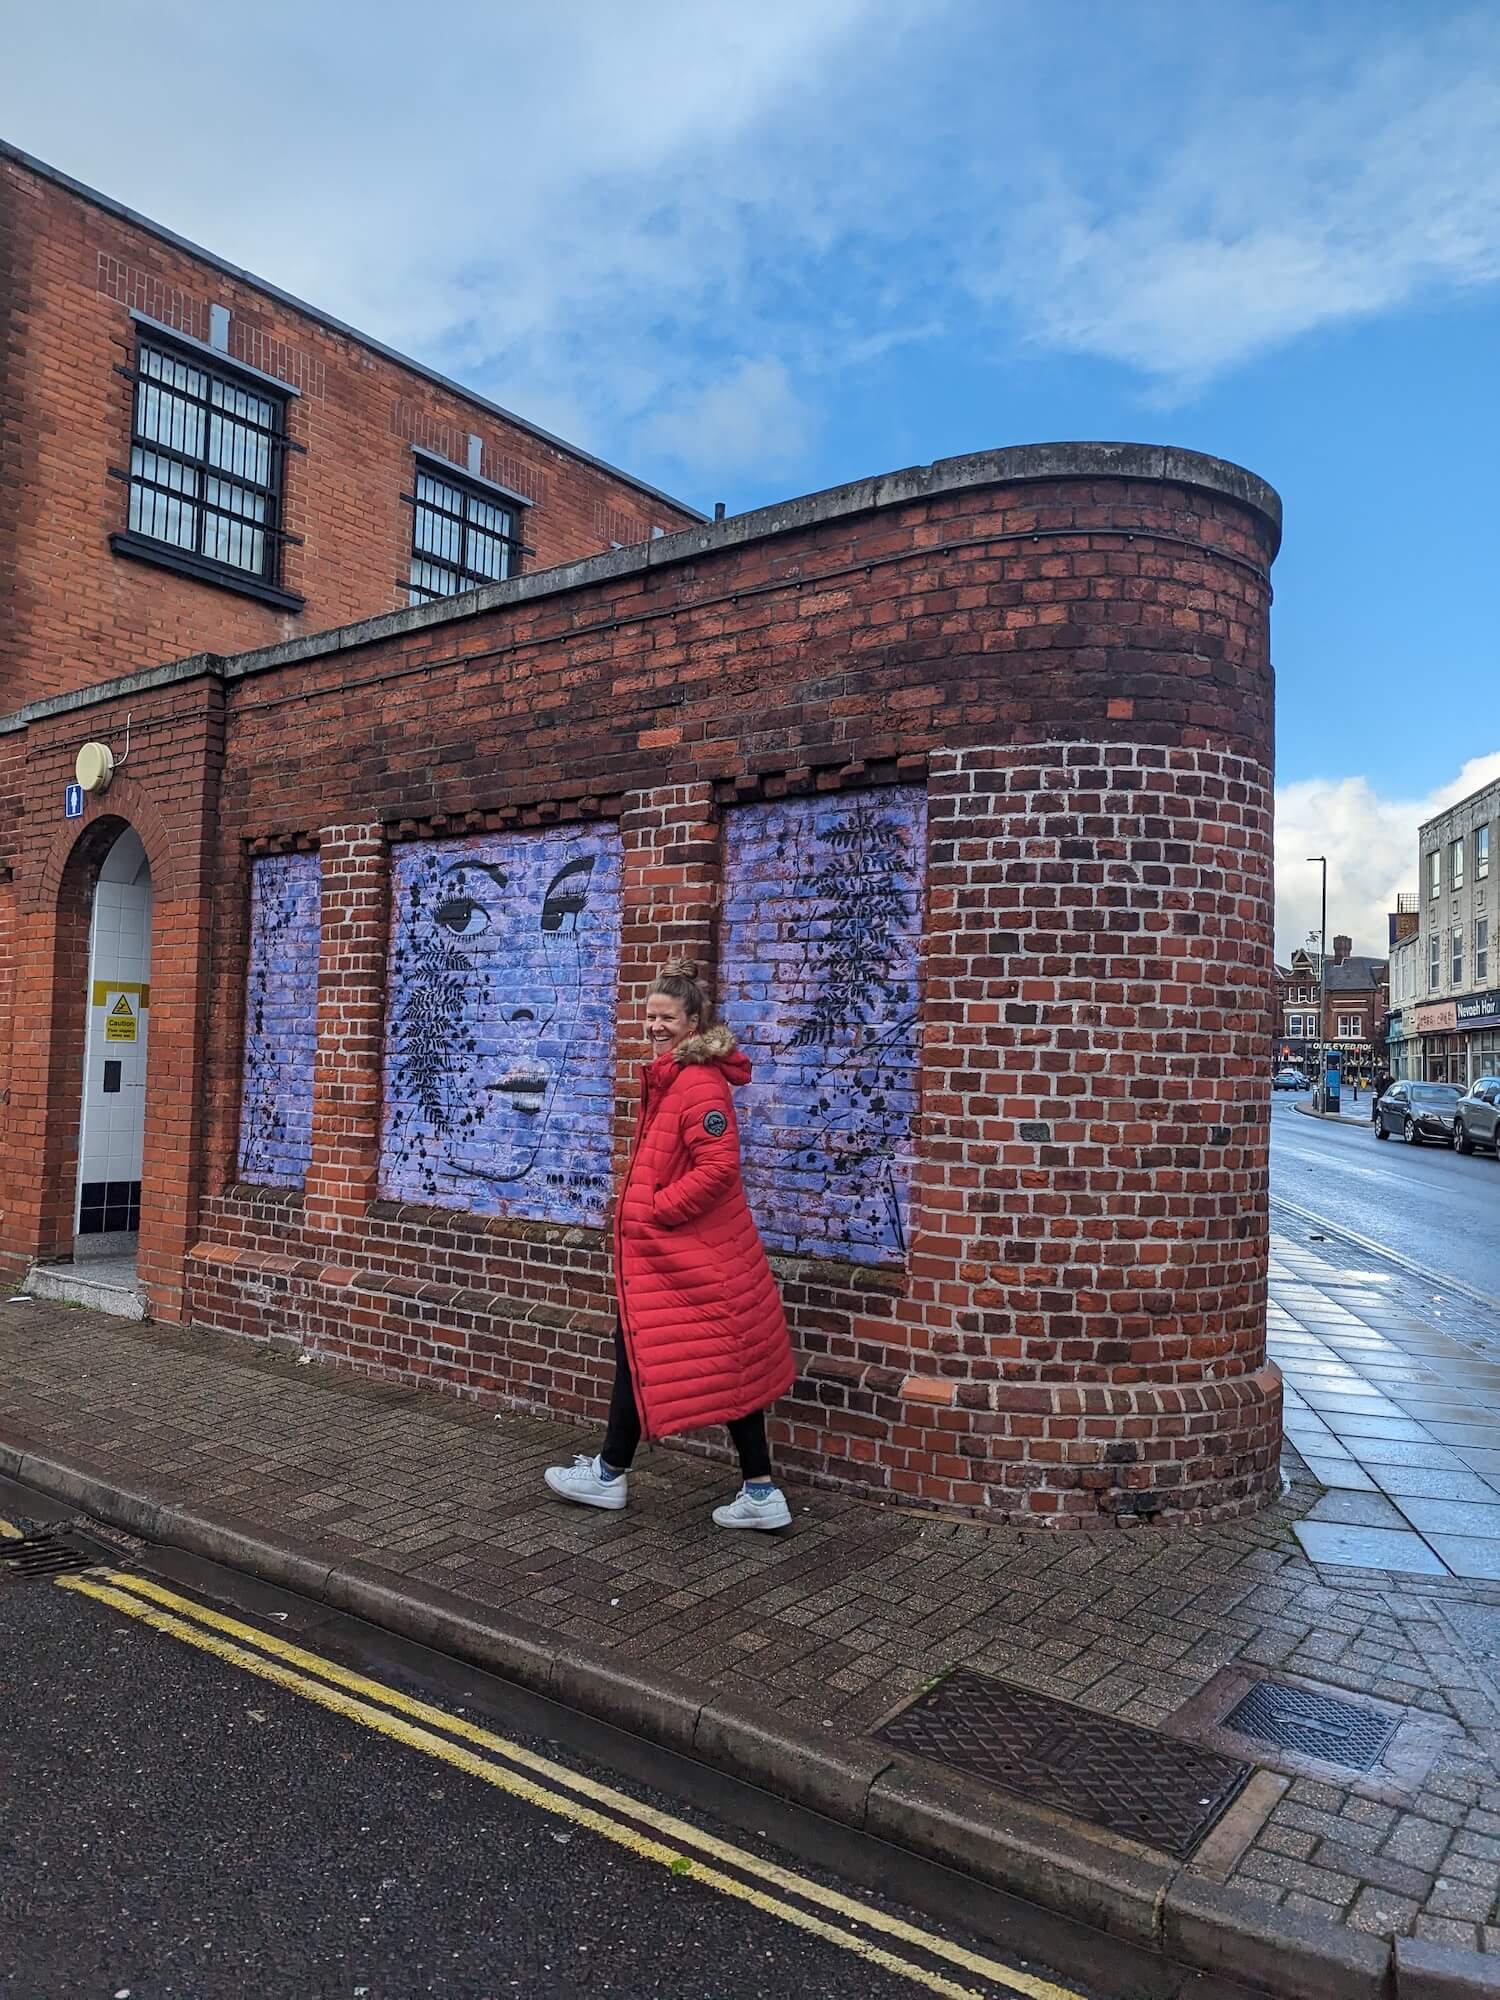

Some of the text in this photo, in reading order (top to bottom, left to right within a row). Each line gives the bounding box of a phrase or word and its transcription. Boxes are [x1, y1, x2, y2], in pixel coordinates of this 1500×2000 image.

[1457, 997, 1495, 1018] Nevaeh Hair
[109, 1019, 135, 1027] Caution
